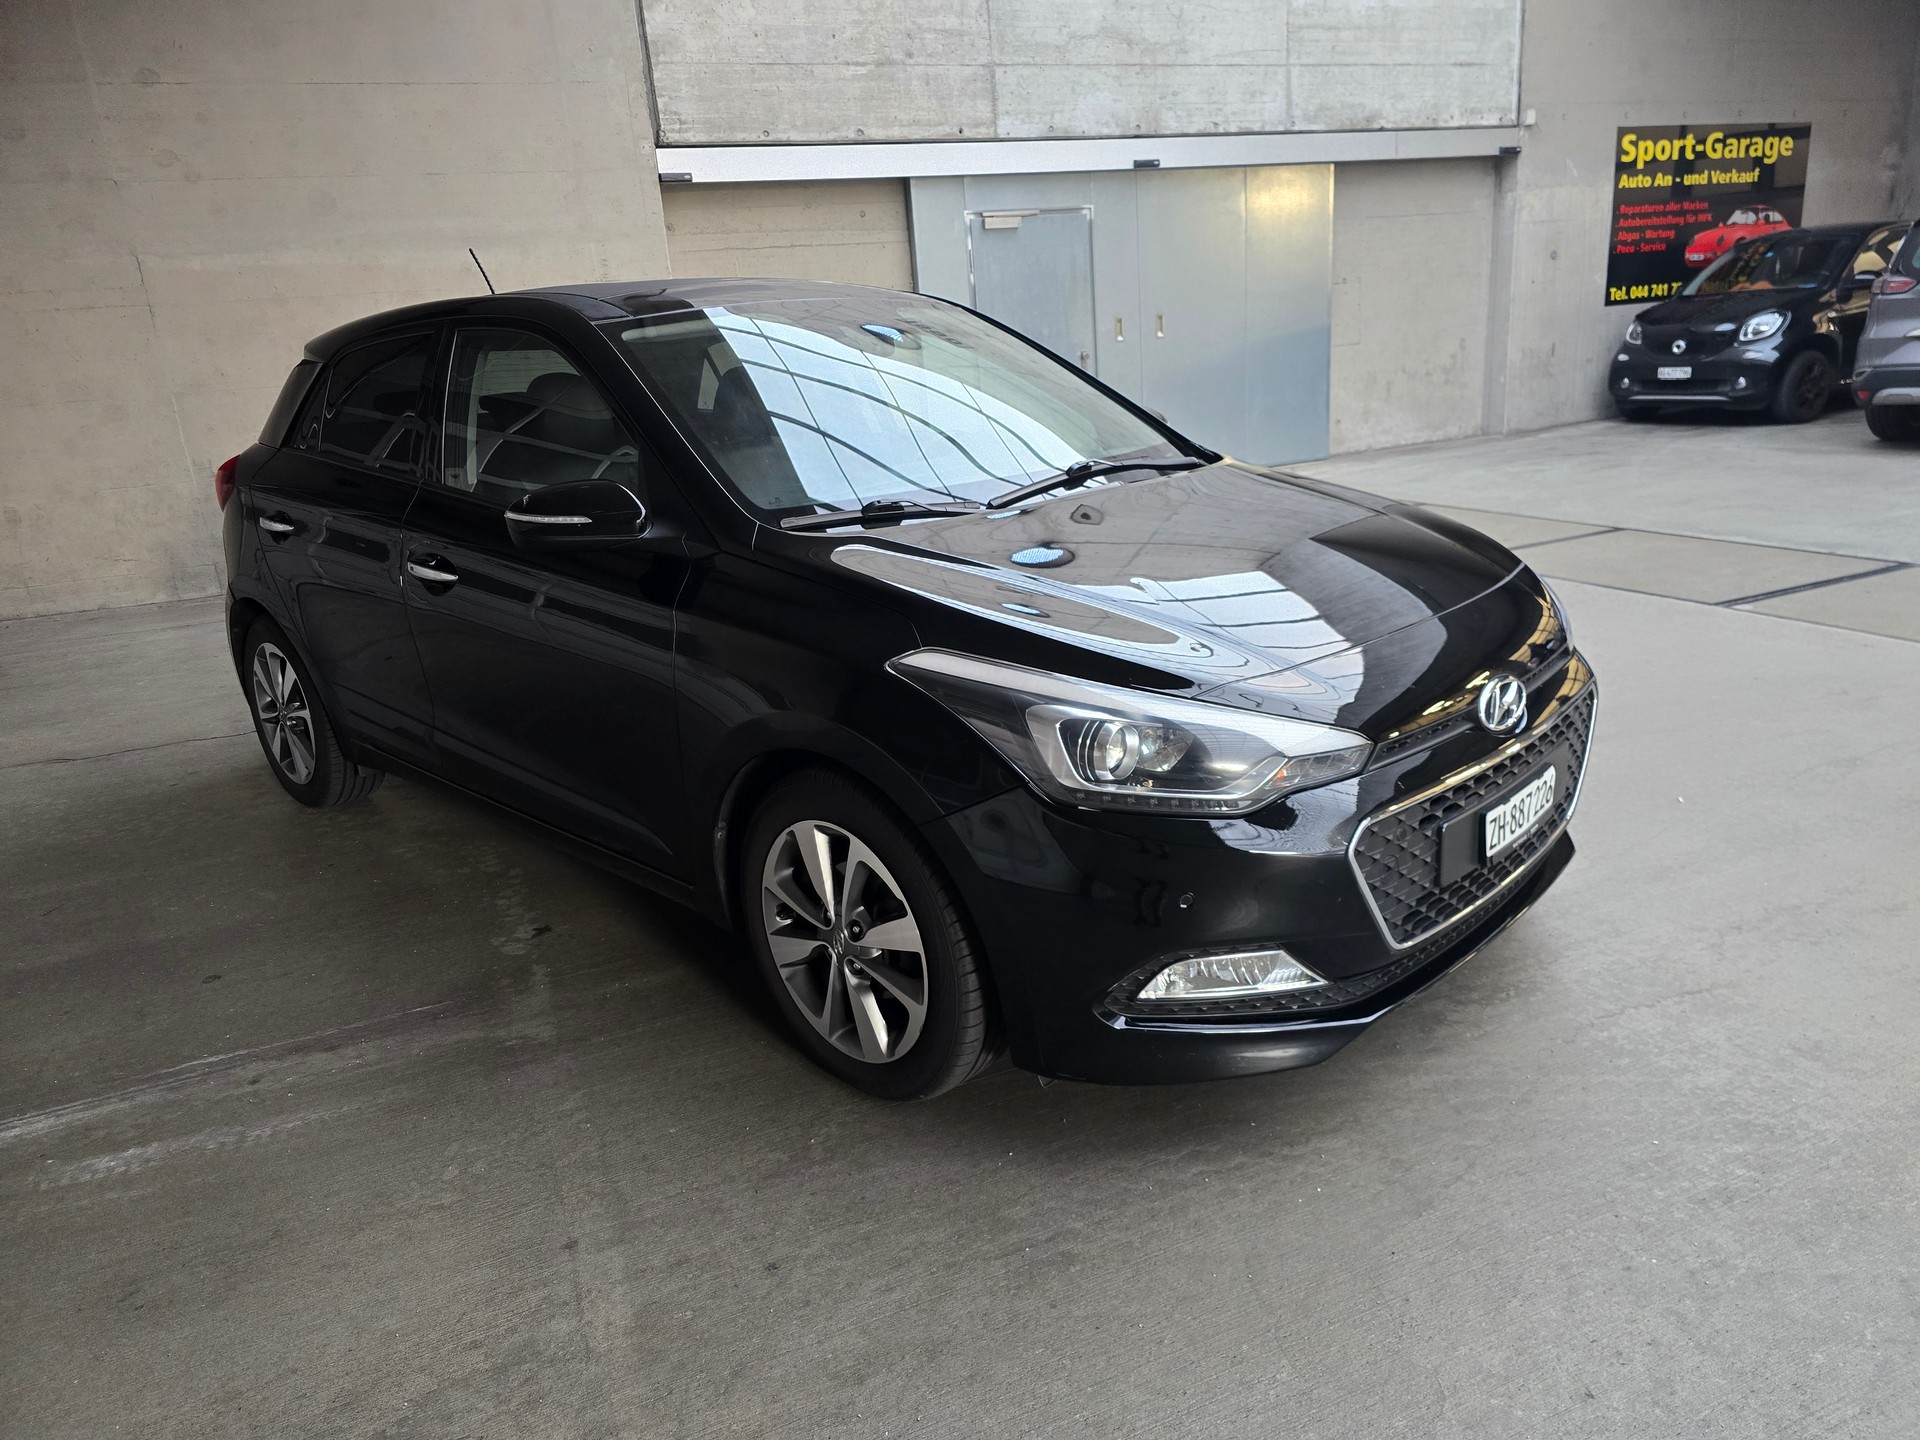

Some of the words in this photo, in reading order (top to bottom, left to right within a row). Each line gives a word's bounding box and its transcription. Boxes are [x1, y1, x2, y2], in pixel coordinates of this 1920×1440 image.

[1620, 131, 1794, 169] Sport-Garage
[1618, 172, 1652, 189] Auto
[1654, 172, 1673, 187] An
[1683, 168, 1708, 185] und
[1711, 168, 1760, 184] Verkauf
[1617, 231, 1639, 242] Abgas
[1645, 229, 1675, 240] Wartung
[1616, 244, 1635, 254] Pneu
[1640, 243, 1666, 253] Service
[1609, 286, 1628, 301] Tel.
[1630, 284, 1649, 299] 044
[1650, 283, 1668, 297] 741
